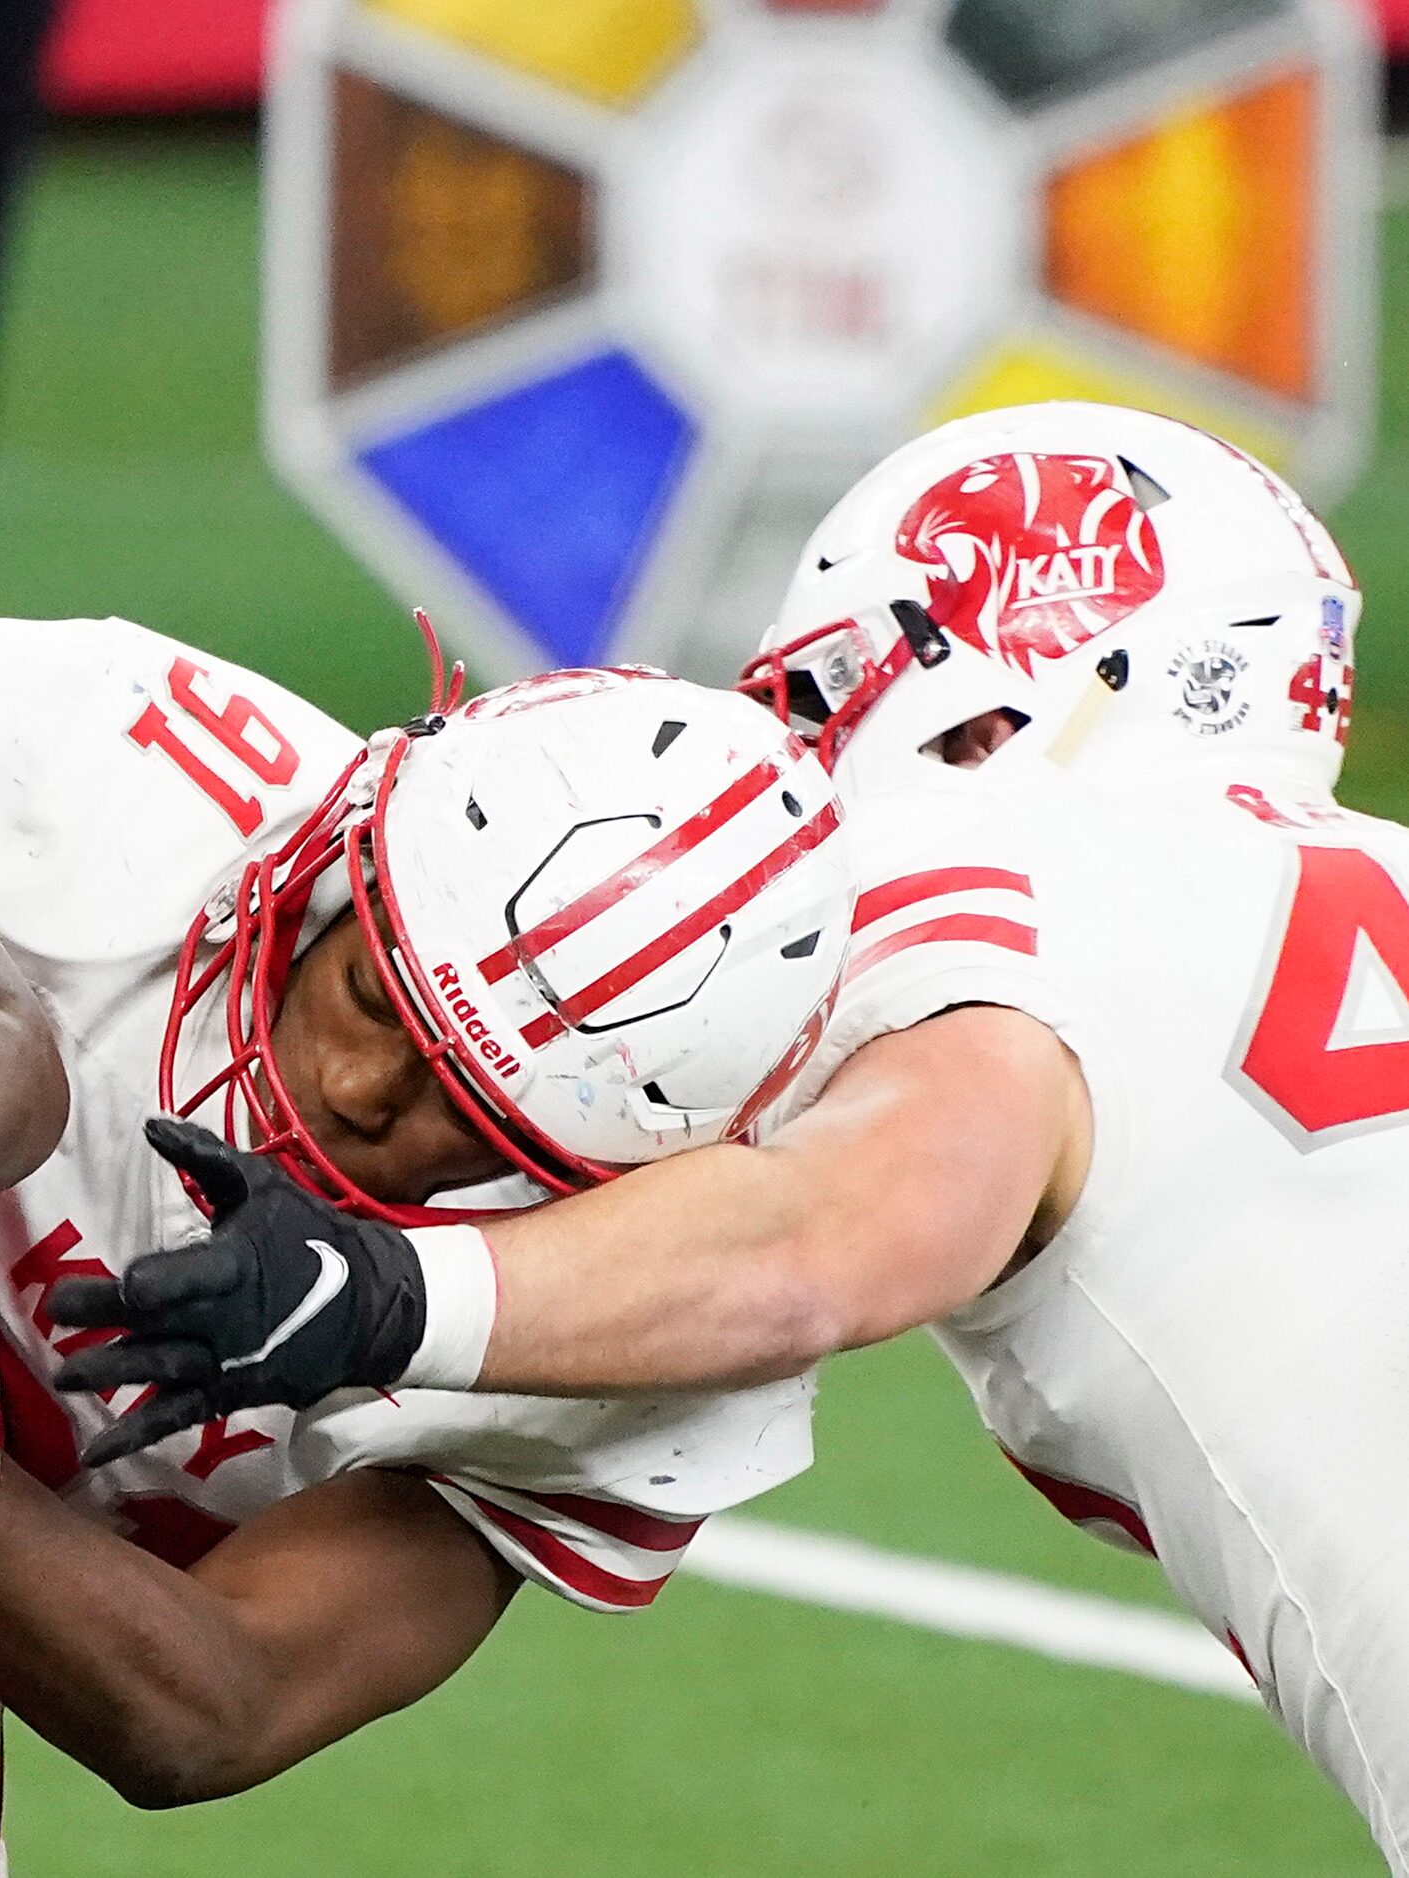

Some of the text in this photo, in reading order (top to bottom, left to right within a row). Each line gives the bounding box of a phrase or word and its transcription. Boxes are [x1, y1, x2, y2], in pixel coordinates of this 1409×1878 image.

[1014, 543, 1123, 601] KATY
[122, 654, 302, 844] 16
[432, 962, 521, 1079] Riddell
